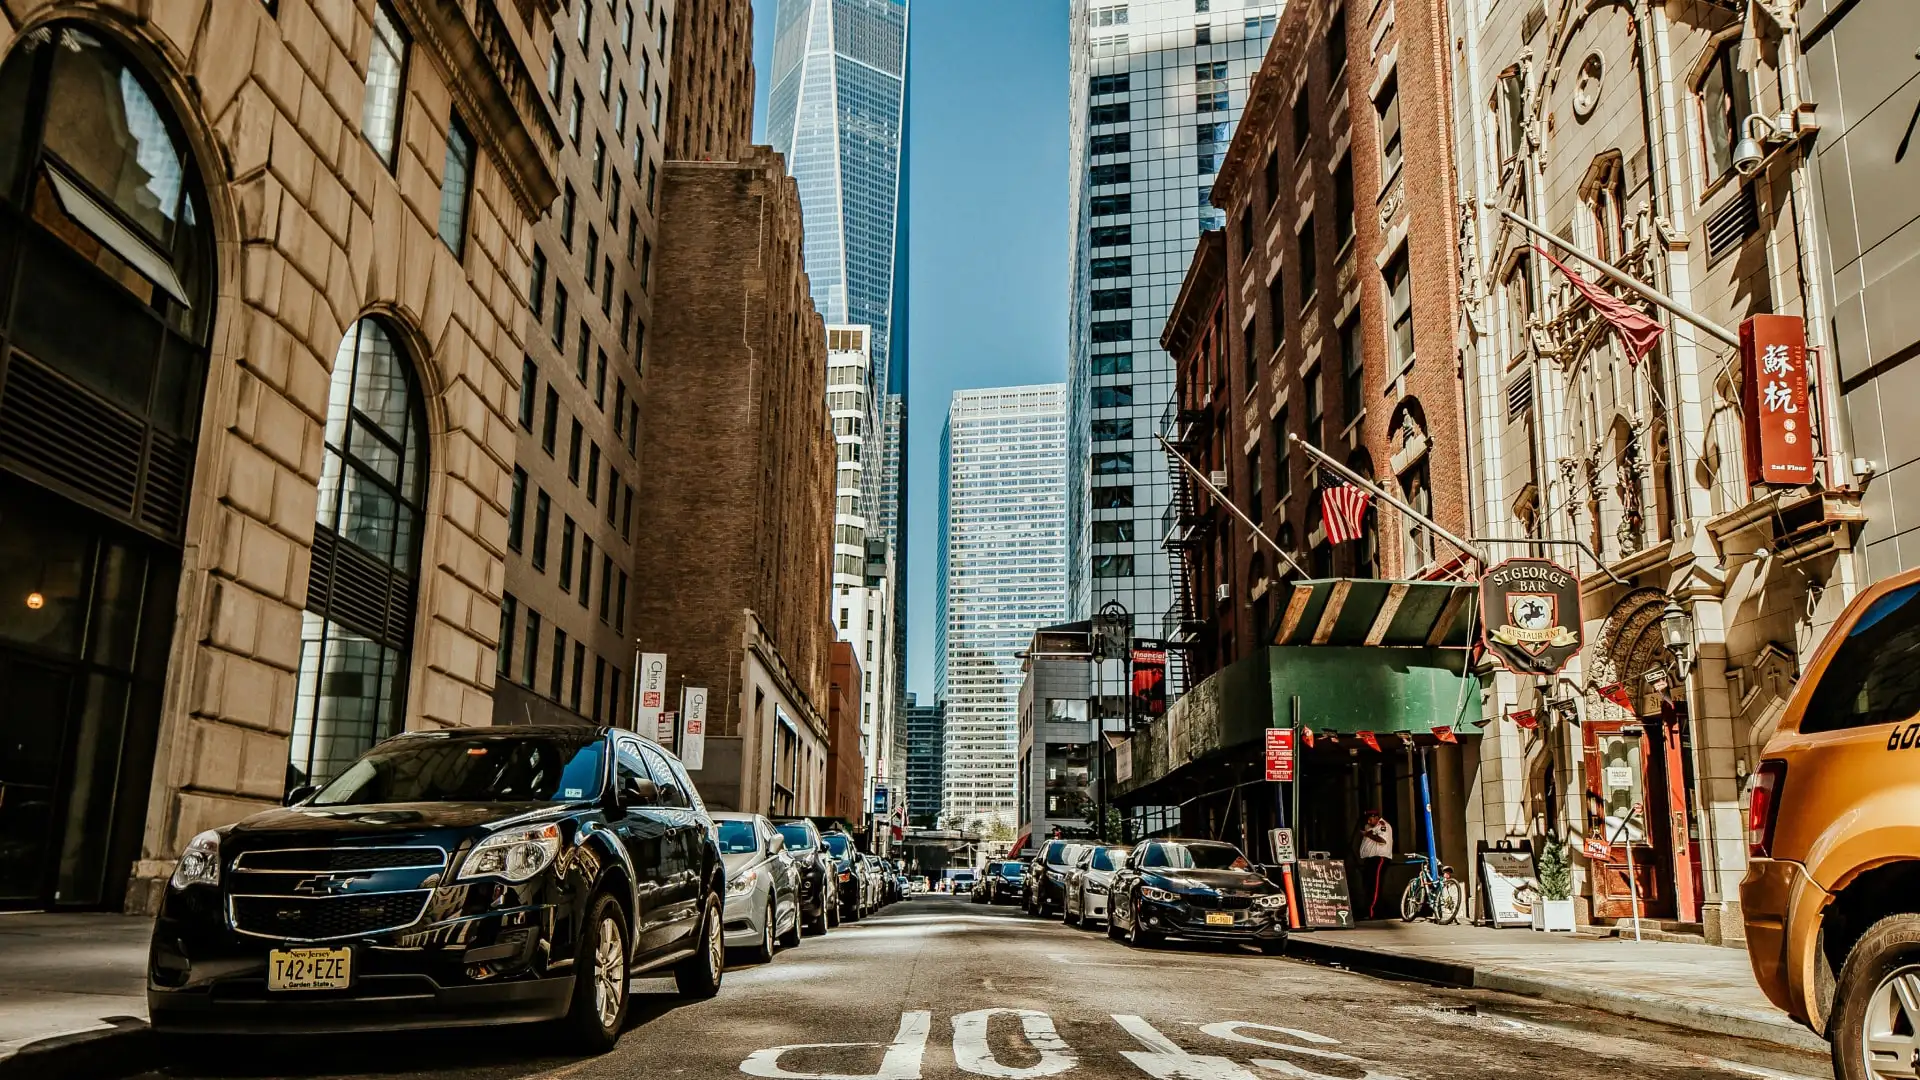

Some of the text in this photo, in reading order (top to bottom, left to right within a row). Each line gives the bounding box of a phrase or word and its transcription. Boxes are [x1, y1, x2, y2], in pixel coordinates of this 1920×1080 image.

[1520, 580, 1548, 592] BAR
[1506, 628, 1561, 640] RESTAURANT
[1133, 650, 1165, 659] financial
[650, 660, 663, 690] China
[692, 693, 704, 719] China
[307, 950, 330, 959] Jersey
[276, 958, 345, 980] T42 EZE
